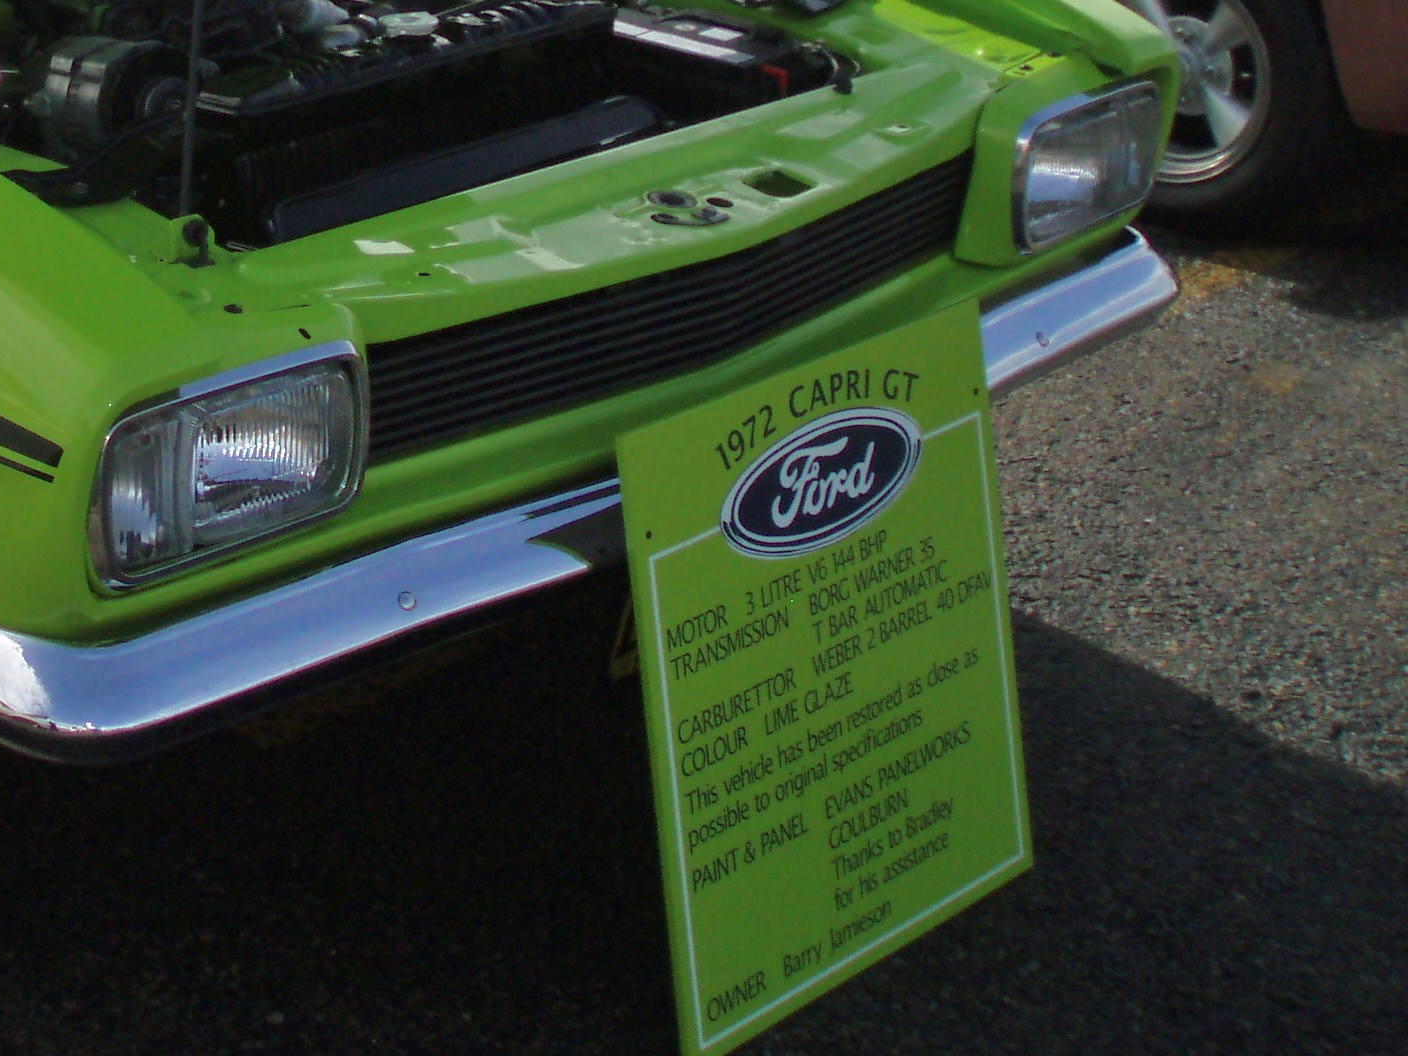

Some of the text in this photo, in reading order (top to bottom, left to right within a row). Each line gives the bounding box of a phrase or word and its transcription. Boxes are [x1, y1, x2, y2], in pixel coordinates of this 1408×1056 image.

[716, 369, 919, 470] 1972 CAPRI GT
[771, 436, 876, 529] Ford
[666, 529, 887, 652] MOTOR 3 LITRE V6 144 BHP
[670, 537, 935, 680] TRANSMISSION BORG WARNER 35
[813, 559, 947, 644] T BAR AUTOMATIC
[678, 571, 992, 744] CARBURETTOR WEBER 2 BARREL 40 DFAV
[681, 672, 854, 777] COLOUR LIME GLAZE
[684, 647, 979, 815] This vehicle has been restored as close as
[688, 709, 923, 855] possible to original specifications
[692, 720, 971, 894] PAINT & PANEL EVANS PANELWORKS
[829, 788, 908, 849] GOULBURN
[832, 797, 954, 880] Thanks to Bradley
[835, 832, 950, 911] for his assistance
[707, 901, 892, 1022] OWNER Barry Jamieson
